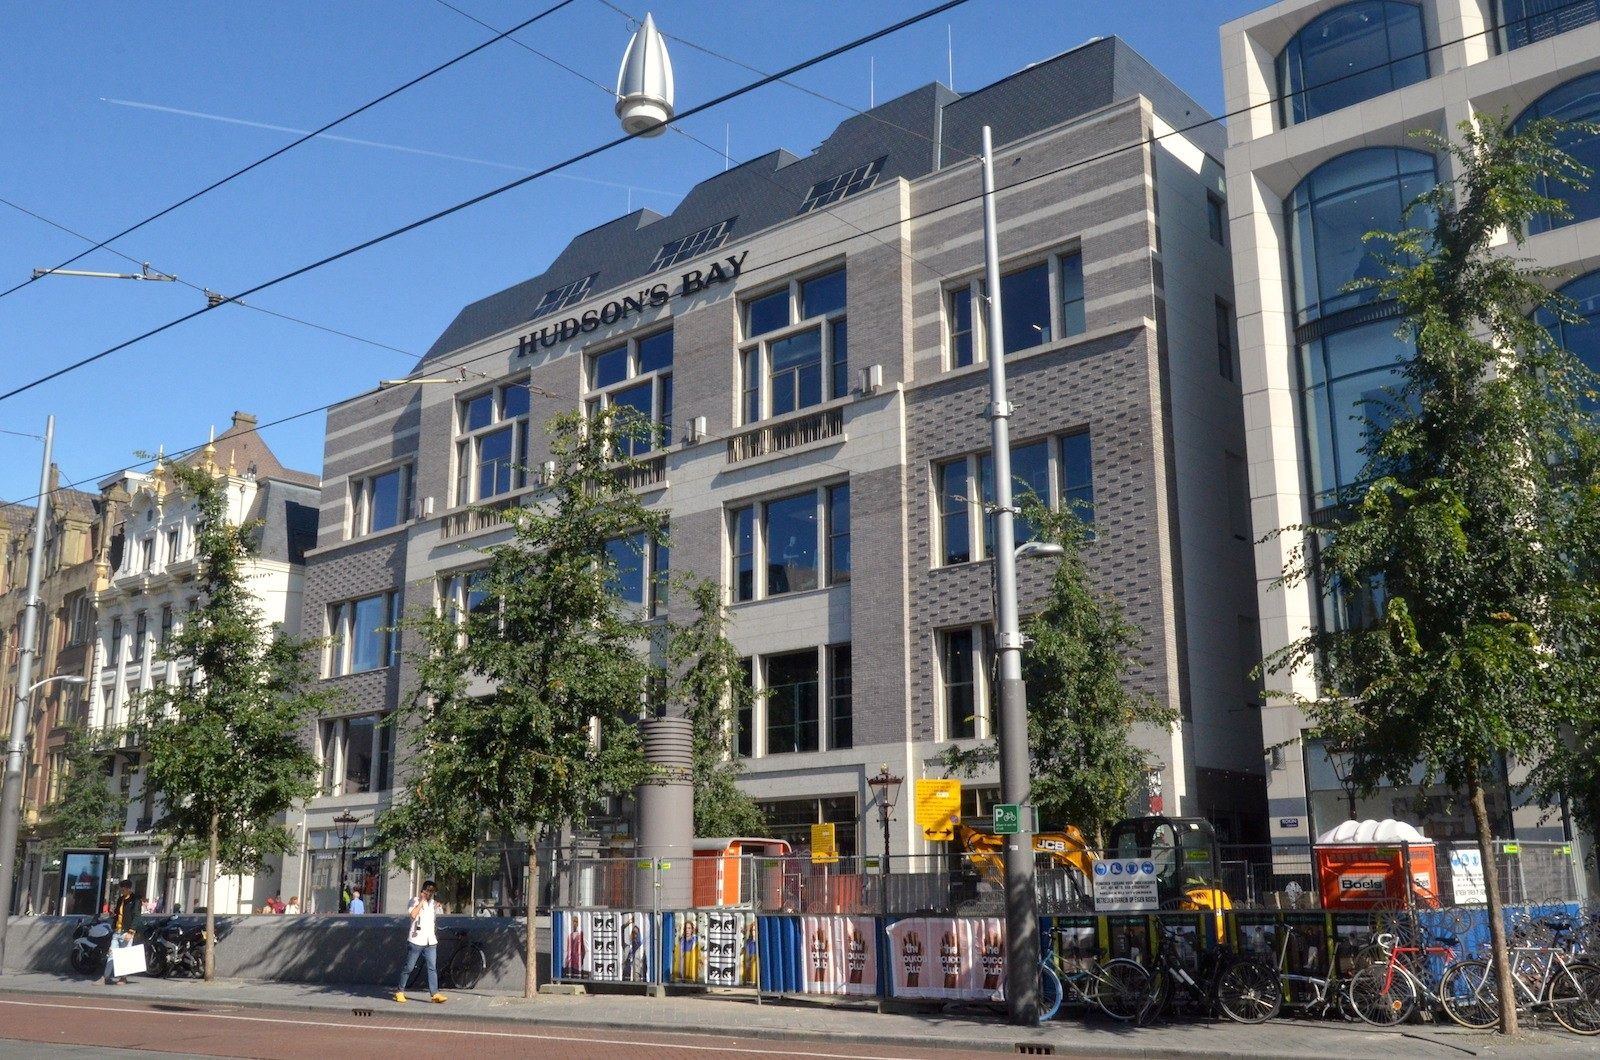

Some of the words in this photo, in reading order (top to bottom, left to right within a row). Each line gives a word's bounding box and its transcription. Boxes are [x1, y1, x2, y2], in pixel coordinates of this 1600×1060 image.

[517, 283, 670, 358] HUDSON'S
[681, 250, 749, 297] BAY
[995, 808, 1004, 822] P
[1036, 839, 1066, 850] JCB
[1341, 879, 1383, 889] Boels
